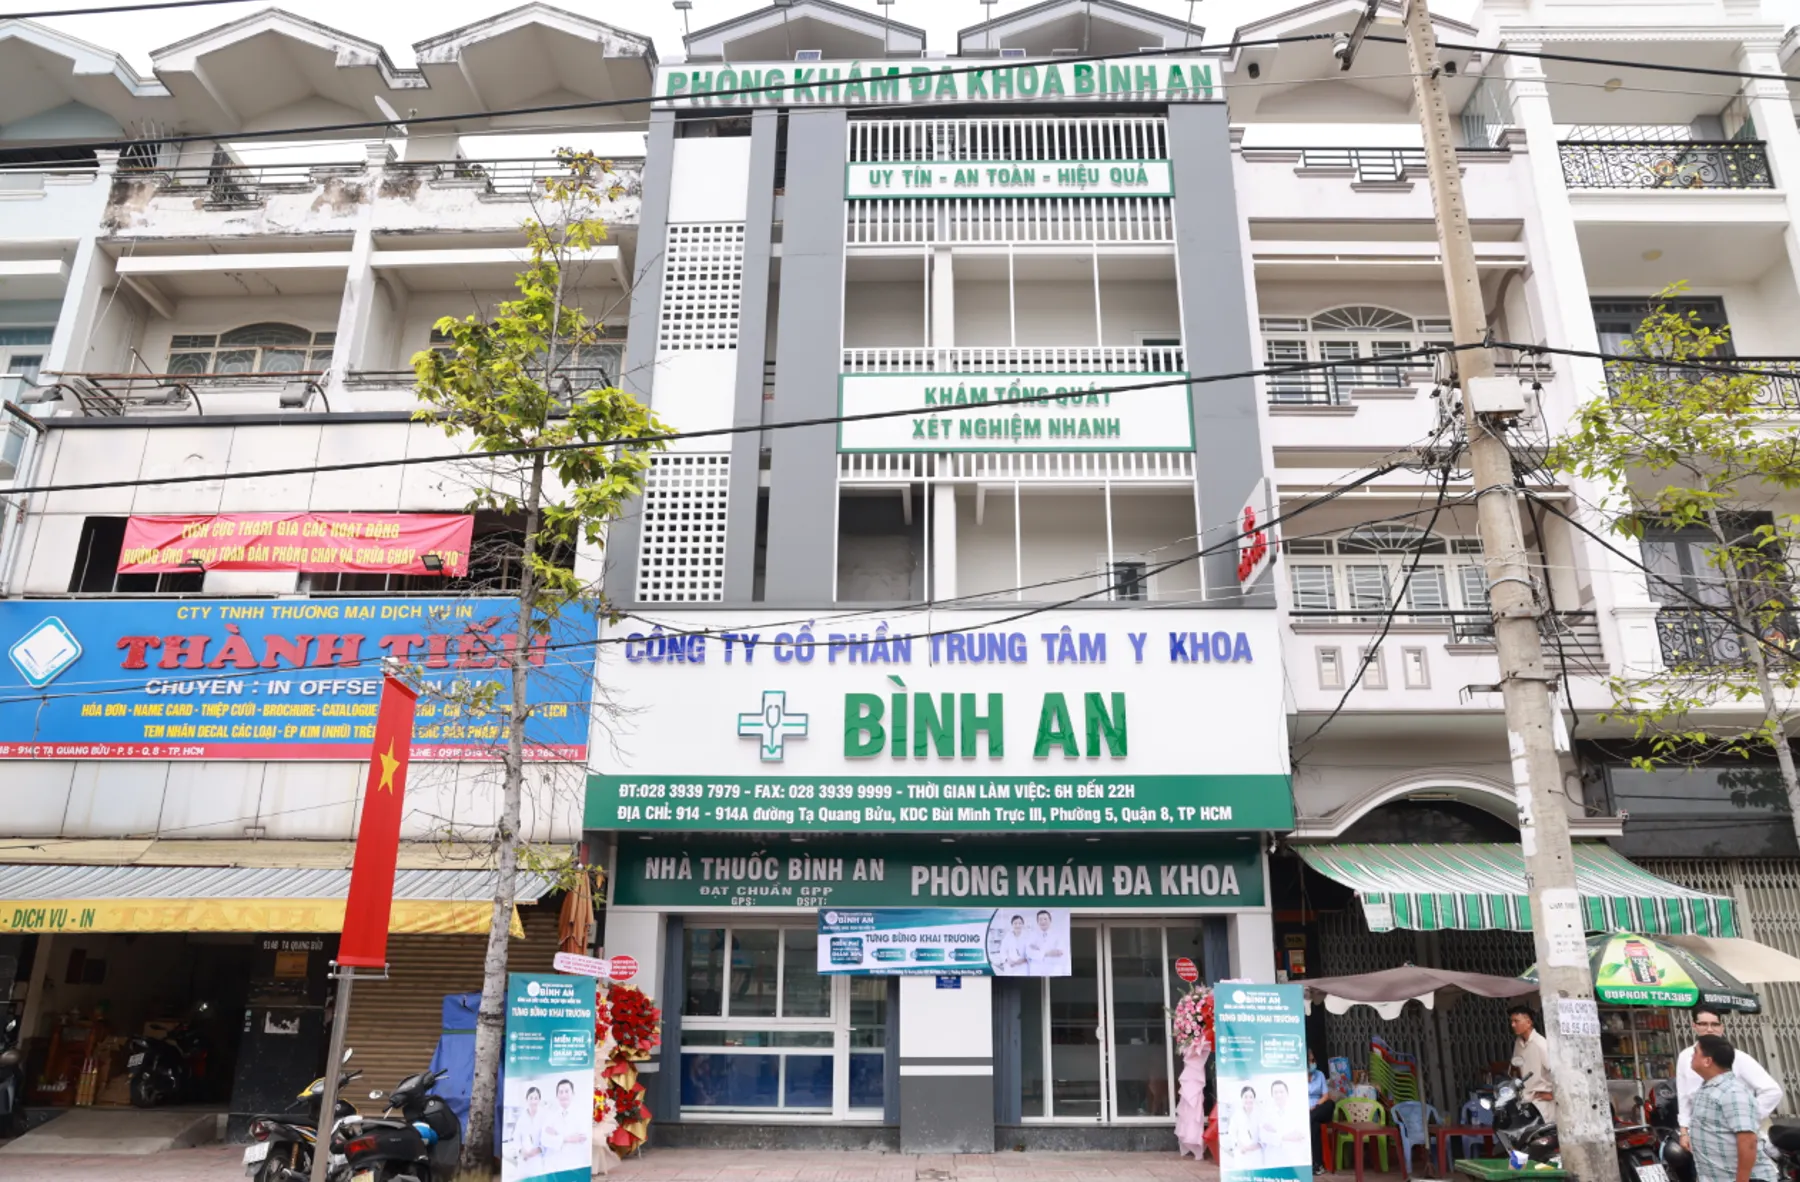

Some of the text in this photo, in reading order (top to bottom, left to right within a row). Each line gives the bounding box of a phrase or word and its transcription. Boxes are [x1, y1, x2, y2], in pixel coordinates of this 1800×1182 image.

[666, 60, 1213, 103] PHÒNG KHÁM ĐA KHOA BÌNH AN
[869, 162, 1149, 190] UY TÍN AN TOÀN HIỆU QUẢ
[924, 378, 1113, 408] KHÁM TỔNG QUÁT
[912, 413, 1121, 443] XÉT NGHIỆM NHANH
[238, 521, 273, 536] THAM
[277, 521, 299, 536] GIA
[303, 520, 327, 537] CÁC
[177, 606, 212, 620] CTY
[220, 606, 265, 619] TNHH
[271, 605, 339, 619] THƯƠNG
[344, 606, 376, 621] MẠI
[381, 606, 422, 621] DỊCH
[455, 605, 473, 618] IN
[116, 623, 366, 670] THÀNH
[625, 619, 1253, 664] CÔNG TY CỔ PHẦN TRUNG TÂM Y KHOA
[267, 680, 290, 695] IN
[81, 702, 102, 717] HÓA
[133, 704, 164, 717] NAME
[165, 704, 194, 717] CARD
[262, 703, 316, 717] BROCHURE
[321, 703, 378, 717] CATALOGUE
[843, 674, 1129, 759] BÌNH AN
[144, 725, 165, 738] TEM
[197, 725, 228, 738] DECAL
[231, 723, 252, 738] CÁC
[299, 725, 320, 738] KIM
[56, 746, 89, 755] QUANG
[183, 747, 204, 755] HCM
[618, 779, 1135, 801] ĐT:028 3939 7979 FAX: 028 3939 9999 THỜI GIAN LÀM VIỆC: 6H ĐẾN 22H
[617, 805, 640, 822] ĐỊA
[645, 802, 672, 820] CHỈ:
[676, 806, 700, 820] 914
[715, 806, 749, 821] 914A
[753, 806, 794, 823] đường
[798, 807, 815, 824] Tạ
[819, 807, 861, 823] Quang
[865, 805, 896, 823] Bửu,
[900, 807, 928, 821] KDC
[932, 806, 954, 821] Bùi
[958, 807, 991, 821] Minh
[995, 807, 1025, 824] Trực
[1050, 807, 1101, 824] Phường
[1105, 807, 1118, 823] 5,
[1121, 806, 1156, 824] Quận
[1160, 807, 1174, 823] 8,
[1178, 807, 1196, 821] TP
[1200, 806, 1232, 820] HCM
[645, 850, 884, 881] NHÀ THUỐC BÌNH AN
[911, 857, 1240, 896] PHÒNG KHÁM ĐA KHOA
[800, 886, 833, 896] GPP
[12, 908, 46, 932] DỊCH
[50, 908, 68, 932] VỤ
[80, 908, 96, 928] IN
[919, 934, 941, 943] KHAI
[562, 989, 574, 997] AN
